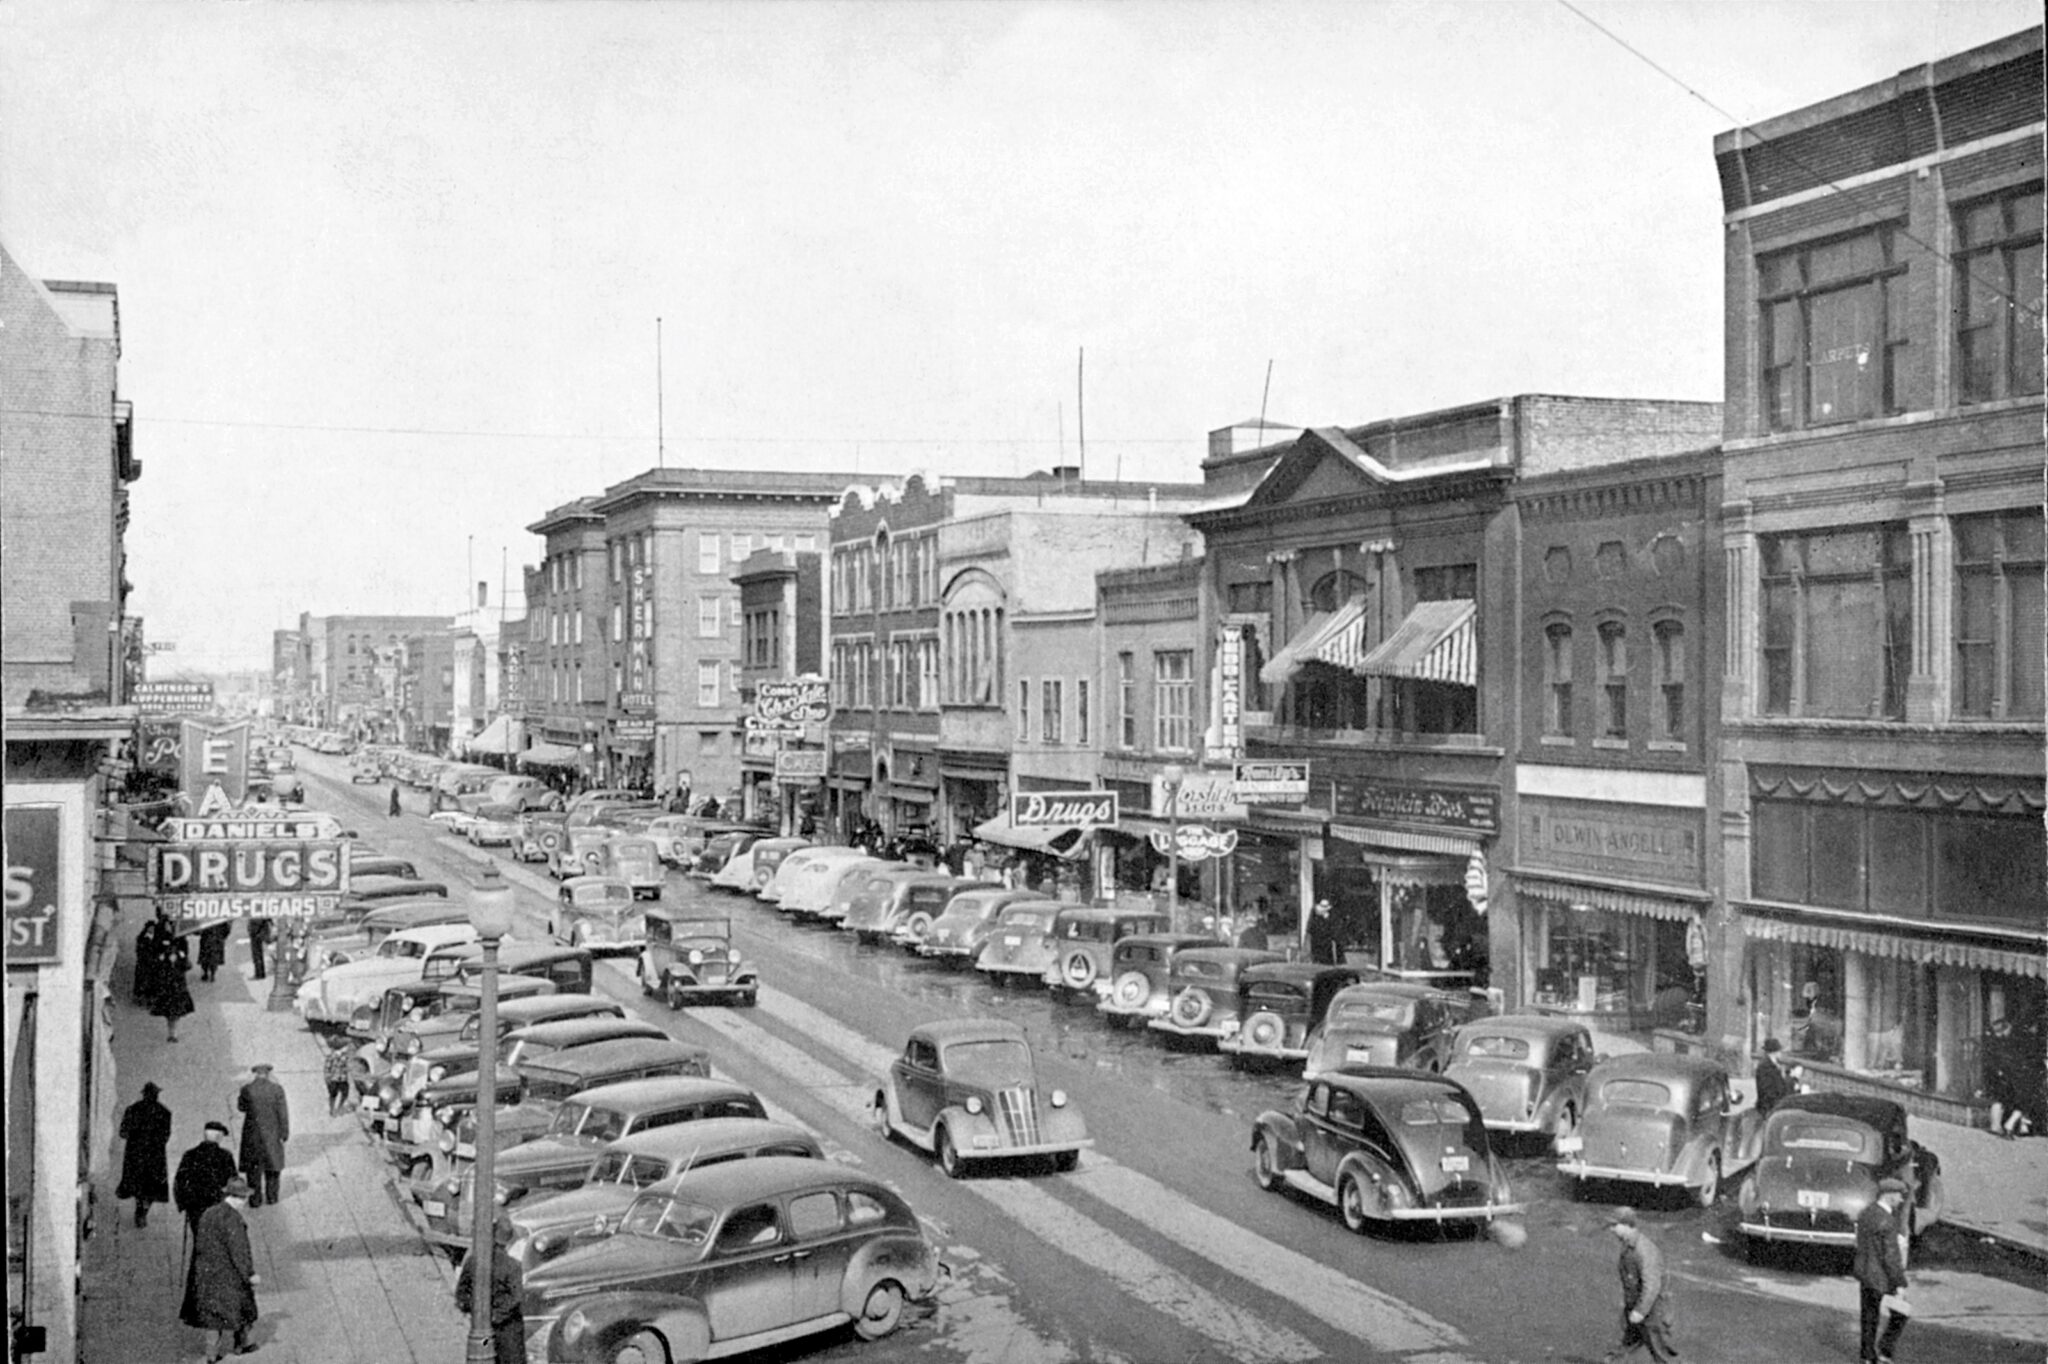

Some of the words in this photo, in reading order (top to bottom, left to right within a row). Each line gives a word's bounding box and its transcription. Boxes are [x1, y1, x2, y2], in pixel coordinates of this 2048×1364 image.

[633, 570, 644, 691] SHERMAN
[621, 694, 654, 706] HOTEL
[1018, 795, 1111, 830] Drugs
[162, 850, 338, 889] DRUGS
